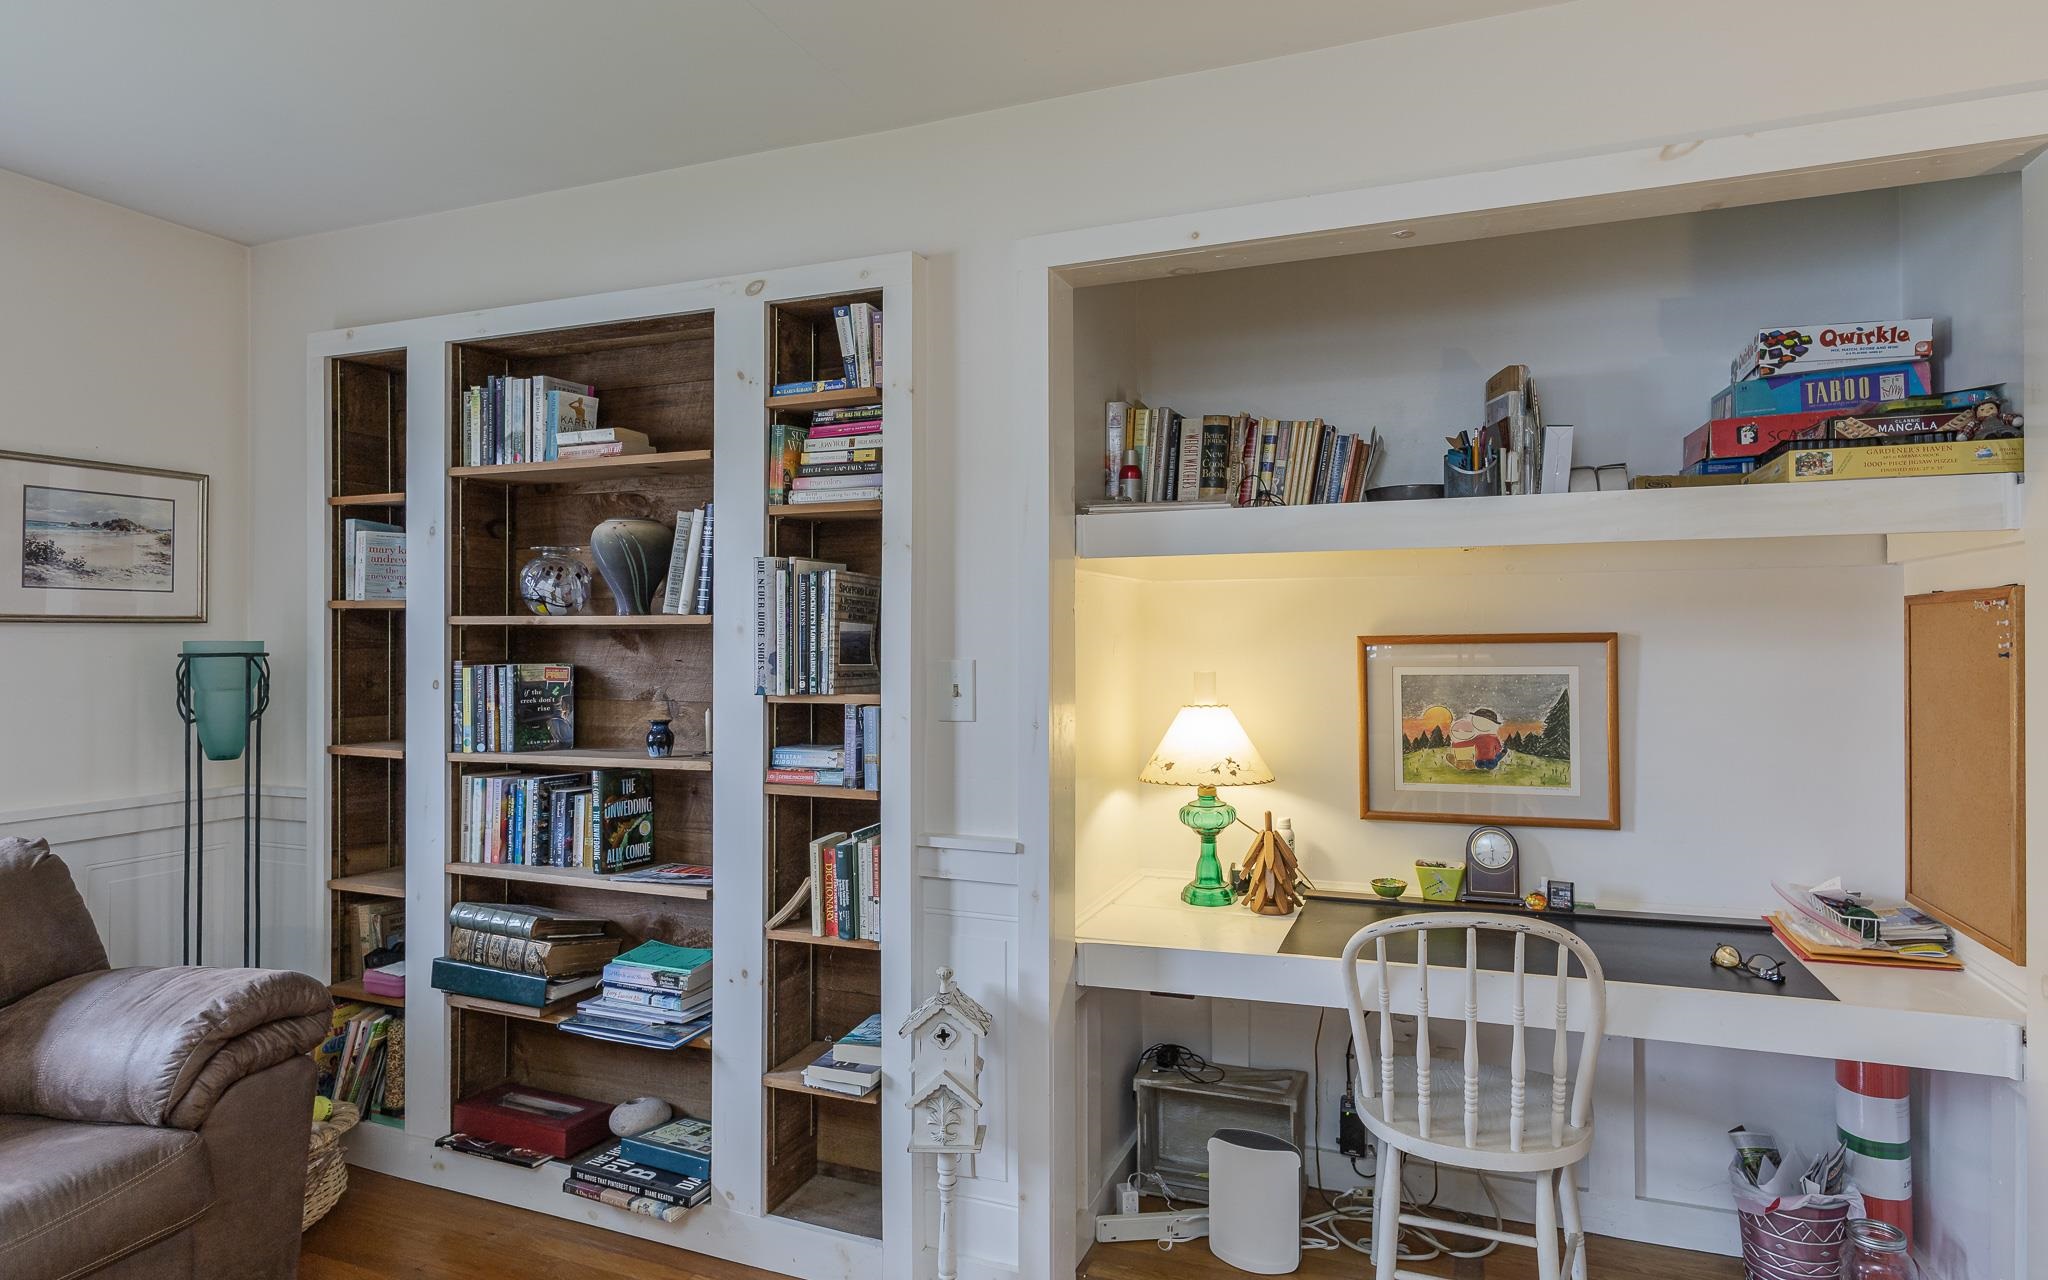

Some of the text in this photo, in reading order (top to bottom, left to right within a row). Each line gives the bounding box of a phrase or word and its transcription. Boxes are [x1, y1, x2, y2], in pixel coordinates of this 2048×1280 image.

[1819, 325, 1910, 347] Qwirkle
[1805, 376, 1870, 404] TABOO
[560, 416, 594, 429] KAREN
[1878, 422, 1938, 433] MANCALA
[792, 431, 806, 440] SUS
[1767, 430, 1800, 442] SCA
[1206, 450, 1224, 458] New
[1866, 444, 1953, 455] GARDENER'S HAVEN
[1182, 434, 1199, 488] WEIGHT WATCHERS
[1202, 459, 1224, 468] Cook
[1202, 469, 1224, 478] Book
[368, 545, 406, 554] mary k
[757, 560, 765, 670] WE NEVER WORE SHOES
[524, 689, 530, 698] if
[621, 778, 636, 795] THE
[604, 796, 652, 819] UNWEDDING
[607, 842, 651, 864] ALLY CONDIE
[825, 863, 834, 923] DICTIONARY
[623, 1168, 657, 1180] B
[585, 1174, 597, 1182] HOUSE
[597, 1176, 607, 1185] THAT
[608, 1179, 628, 1190] PINTEREST
[629, 1184, 641, 1193] BUILT
[644, 1189, 657, 1199] DIANE
[658, 1192, 674, 1202] KEATON
